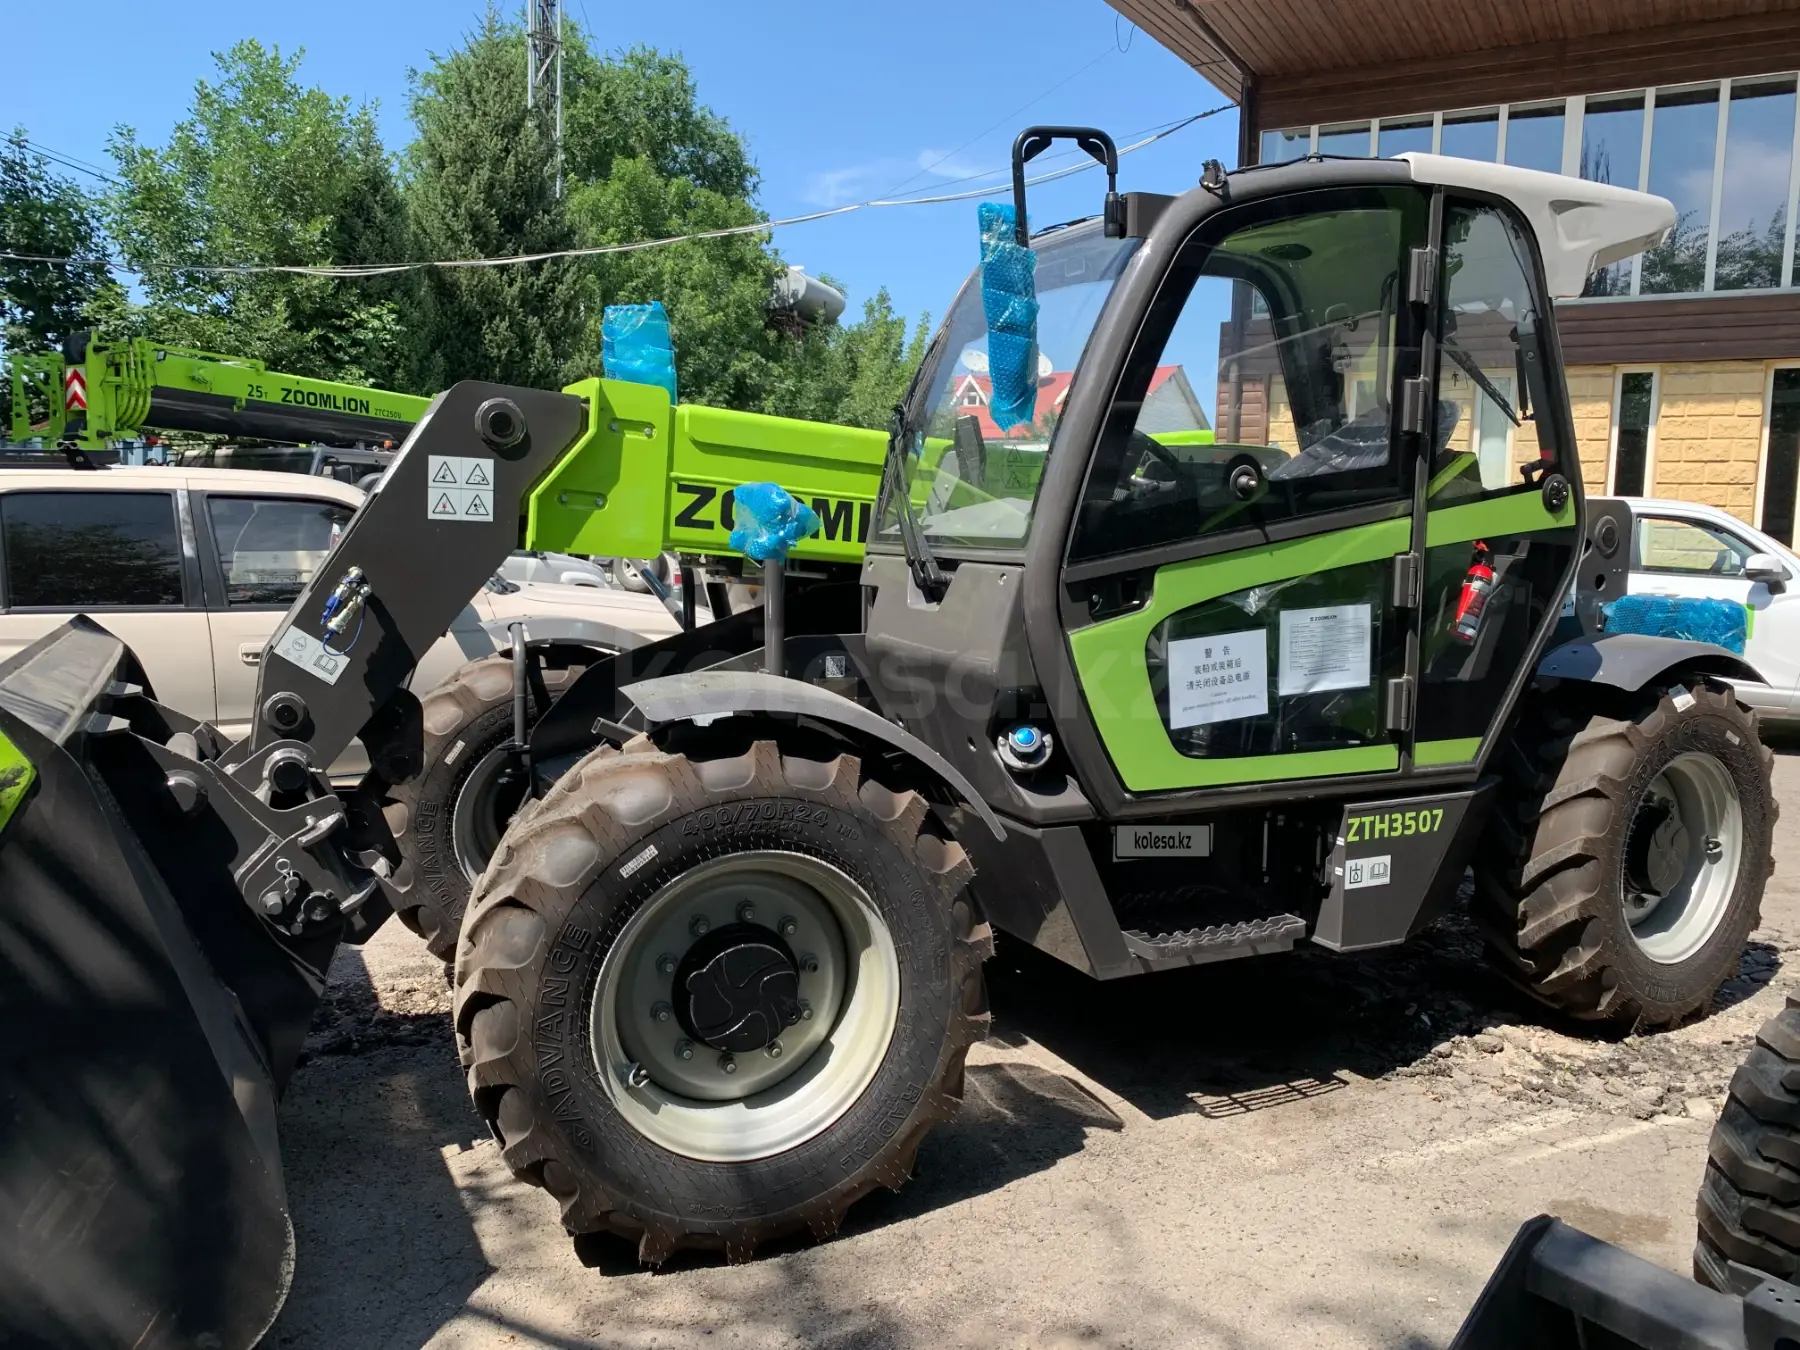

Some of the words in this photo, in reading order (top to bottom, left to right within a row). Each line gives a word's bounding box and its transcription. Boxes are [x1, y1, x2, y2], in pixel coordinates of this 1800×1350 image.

[280, 387, 370, 415] ZOOMLION
[682, 802, 829, 836] 400/70R24
[1347, 809, 1444, 842] ZTH3507
[536, 921, 591, 1122] ADVANCE
[840, 1081, 924, 1169] RADIAL
